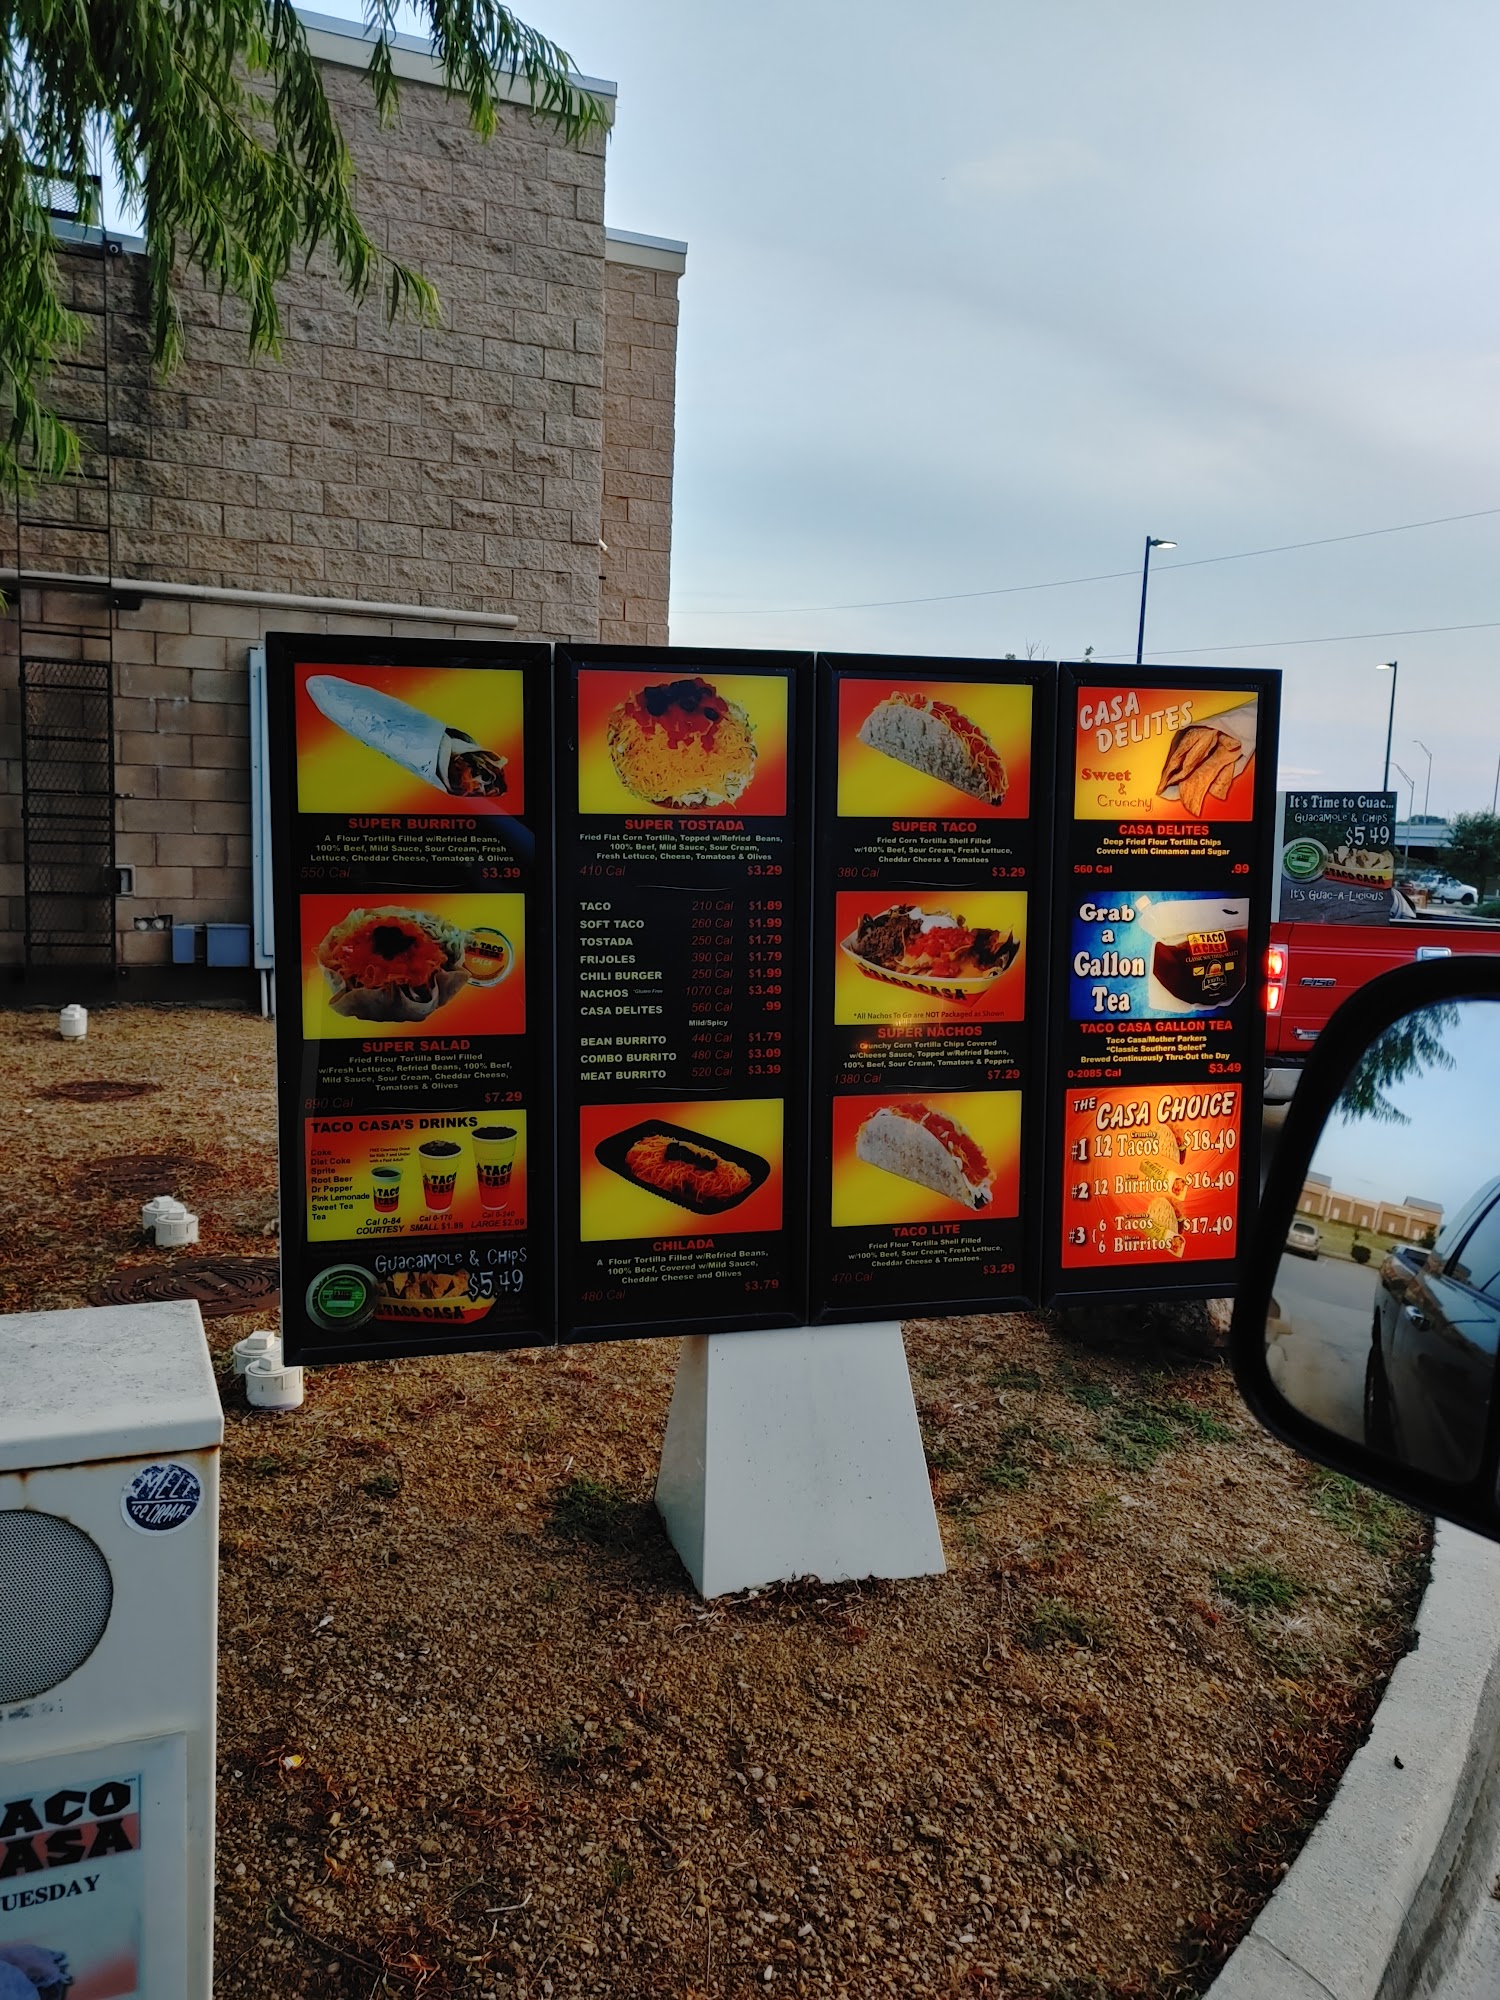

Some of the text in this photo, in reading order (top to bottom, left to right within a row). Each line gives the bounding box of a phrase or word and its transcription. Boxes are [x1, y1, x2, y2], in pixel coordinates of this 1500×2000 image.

[1079, 691, 1140, 730] CASA
[1095, 700, 1193, 753] DELITES
[1081, 768, 1131, 781] Sweet
[1117, 783, 1127, 795] &
[1097, 795, 1153, 812] Crunchy
[1289, 794, 1308, 809] It's
[1311, 796, 1340, 809] Time
[1342, 797, 1354, 809] to
[348, 818, 477, 830] SUPER BURRITO
[1350, 813, 1358, 823] &
[624, 819, 745, 832] SUPER TOSTADA
[891, 821, 977, 833] SUPER TACO
[1119, 825, 1210, 836] CASA DELITES
[337, 835, 360, 843] Flour
[363, 835, 396, 843] Tortilla
[398, 835, 423, 843] Filled
[425, 835, 468, 843] w/Refried
[1344, 826, 1390, 847] $5.49
[482, 867, 521, 879] $3.39
[746, 865, 783, 876] $3.29
[991, 867, 1026, 878] $3.29
[1073, 863, 1250, 874] 560 Cal .99
[1329, 868, 1386, 885] TACO CASA
[580, 900, 783, 911] TACO $1.89
[1078, 903, 1136, 923] Grab
[580, 917, 783, 929] SOFT TACO $1.99
[580, 934, 783, 947] TOSTADA $1.79
[1101, 928, 1115, 943] a
[1200, 932, 1225, 943] TACO
[1202, 943, 1228, 953] CASA
[580, 951, 783, 965] FRIJOLES $1.79
[1073, 951, 1146, 978] Gallon
[580, 968, 783, 981] CHILI BURGER $1.99
[580, 985, 783, 999] NACHOS $3.49
[1091, 985, 1131, 1013] Tea
[580, 1001, 782, 1016] CASA DELITES .99
[867, 1012, 892, 1020] Nachos
[940, 1011, 973, 1019] Packaged
[688, 1019, 729, 1028] Mild/Spicy
[1079, 1019, 1233, 1034] TACO CASA GALLON TEA
[877, 1025, 983, 1039] SUPER NACHOS
[580, 1031, 783, 1047] BEAN BURRITO $1.79
[362, 1039, 471, 1053] SUPER SALAD
[580, 1048, 783, 1064] COMBO BURRITO $3.09
[1080, 1056, 1111, 1064] Brewed
[1112, 1054, 1164, 1063] Continuously
[1165, 1053, 1200, 1062] Thru-Out
[1215, 1052, 1231, 1061] Day
[580, 1064, 783, 1081] MEAT BURRITO $3.39
[986, 1069, 1021, 1081] $7.29
[1067, 1062, 1242, 1079] 0-2085 Cal $3.49
[484, 1091, 523, 1103] $7.29
[1073, 1091, 1236, 1130] THE CASA CHOICE
[311, 1116, 478, 1134] TACO CASA'S DRINKS
[1071, 1128, 1236, 1161] #1 12 Tacos $18.40
[311, 1149, 332, 1157] Coke
[311, 1157, 351, 1165] Diet Coke
[311, 1166, 336, 1176] Sprite
[311, 1175, 353, 1184] Root Beer
[1071, 1170, 1235, 1200] #2 12 Burritos $16.40
[311, 1185, 353, 1194] Dr Pepper
[311, 1193, 370, 1202] Pink Lemonade
[311, 1204, 338, 1212] Sweet
[312, 1213, 327, 1221] Tea
[366, 1217, 380, 1226] Cal
[419, 1214, 432, 1222] Cal
[482, 1211, 495, 1219] Cal
[356, 1224, 405, 1235] COURTESY
[409, 1223, 439, 1232] SMALL
[441, 1221, 464, 1231] $1.89
[471, 1220, 501, 1229] LARGE
[892, 1223, 961, 1238] TACO LITE
[1068, 1215, 1234, 1244] #3 $17.40
[1099, 1215, 1153, 1233] 6 Tacos
[652, 1238, 715, 1252] CHILADA
[1098, 1236, 1172, 1254] 6 Burritos
[469, 1249, 480, 1267] &
[982, 1263, 1016, 1276] $3.29
[468, 1268, 524, 1302] $5.49
[744, 1278, 780, 1291] $3.79
[383, 1304, 465, 1319] TACO CASA
